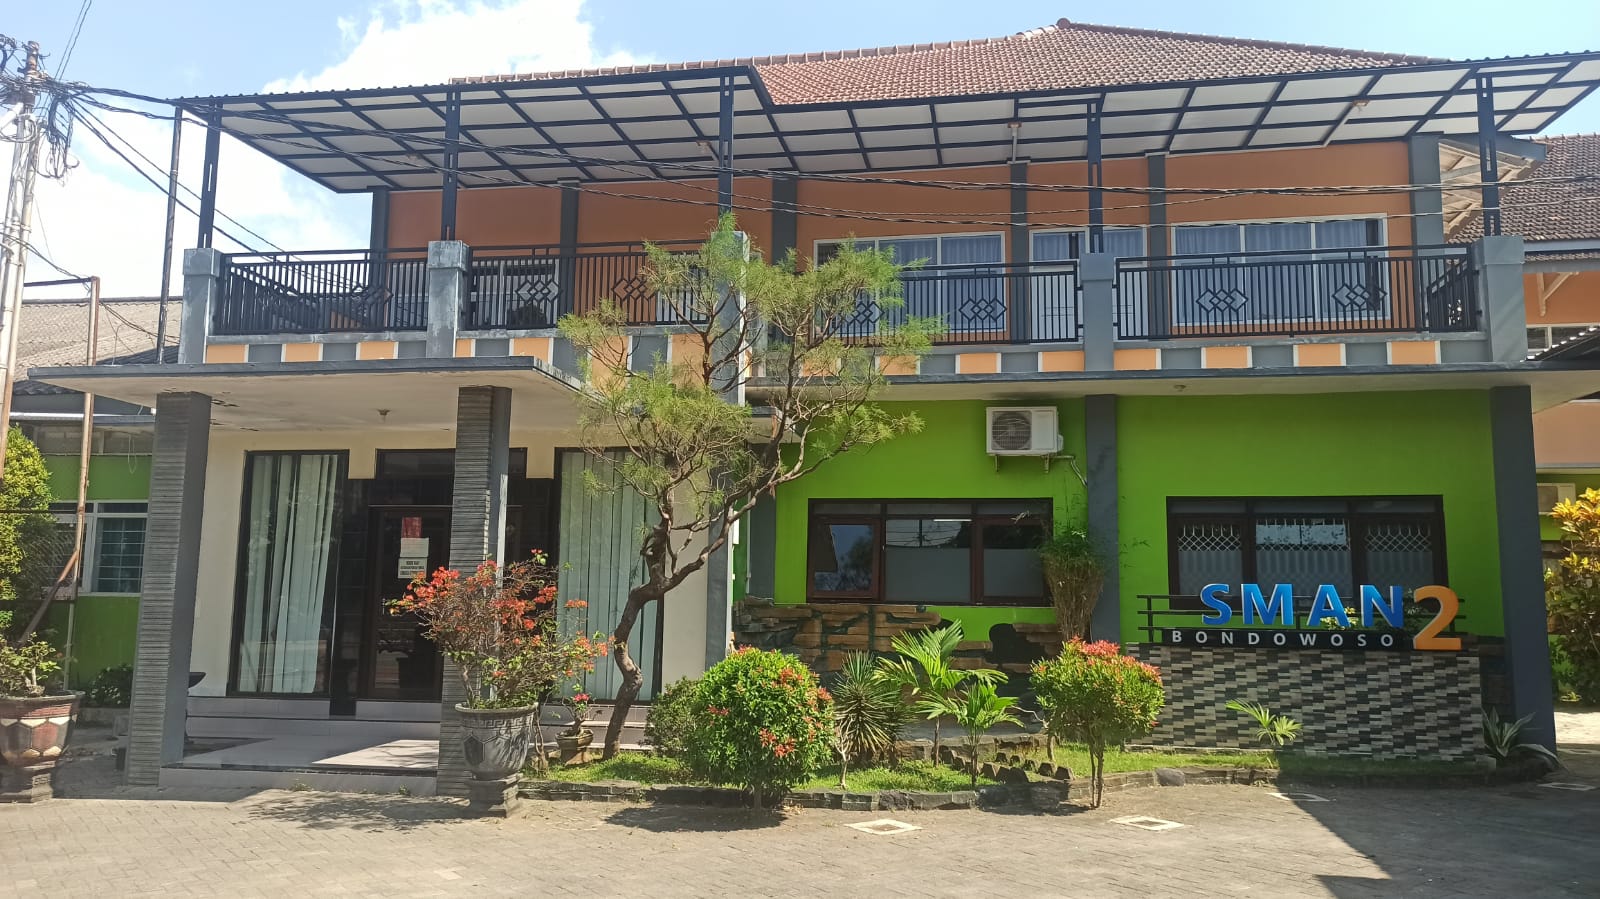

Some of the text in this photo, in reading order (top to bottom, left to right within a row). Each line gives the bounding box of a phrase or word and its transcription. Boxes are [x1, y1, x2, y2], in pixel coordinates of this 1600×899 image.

[1200, 583, 1462, 650] SMAN 2
[1172, 630, 1394, 647] BONDOWOSO
